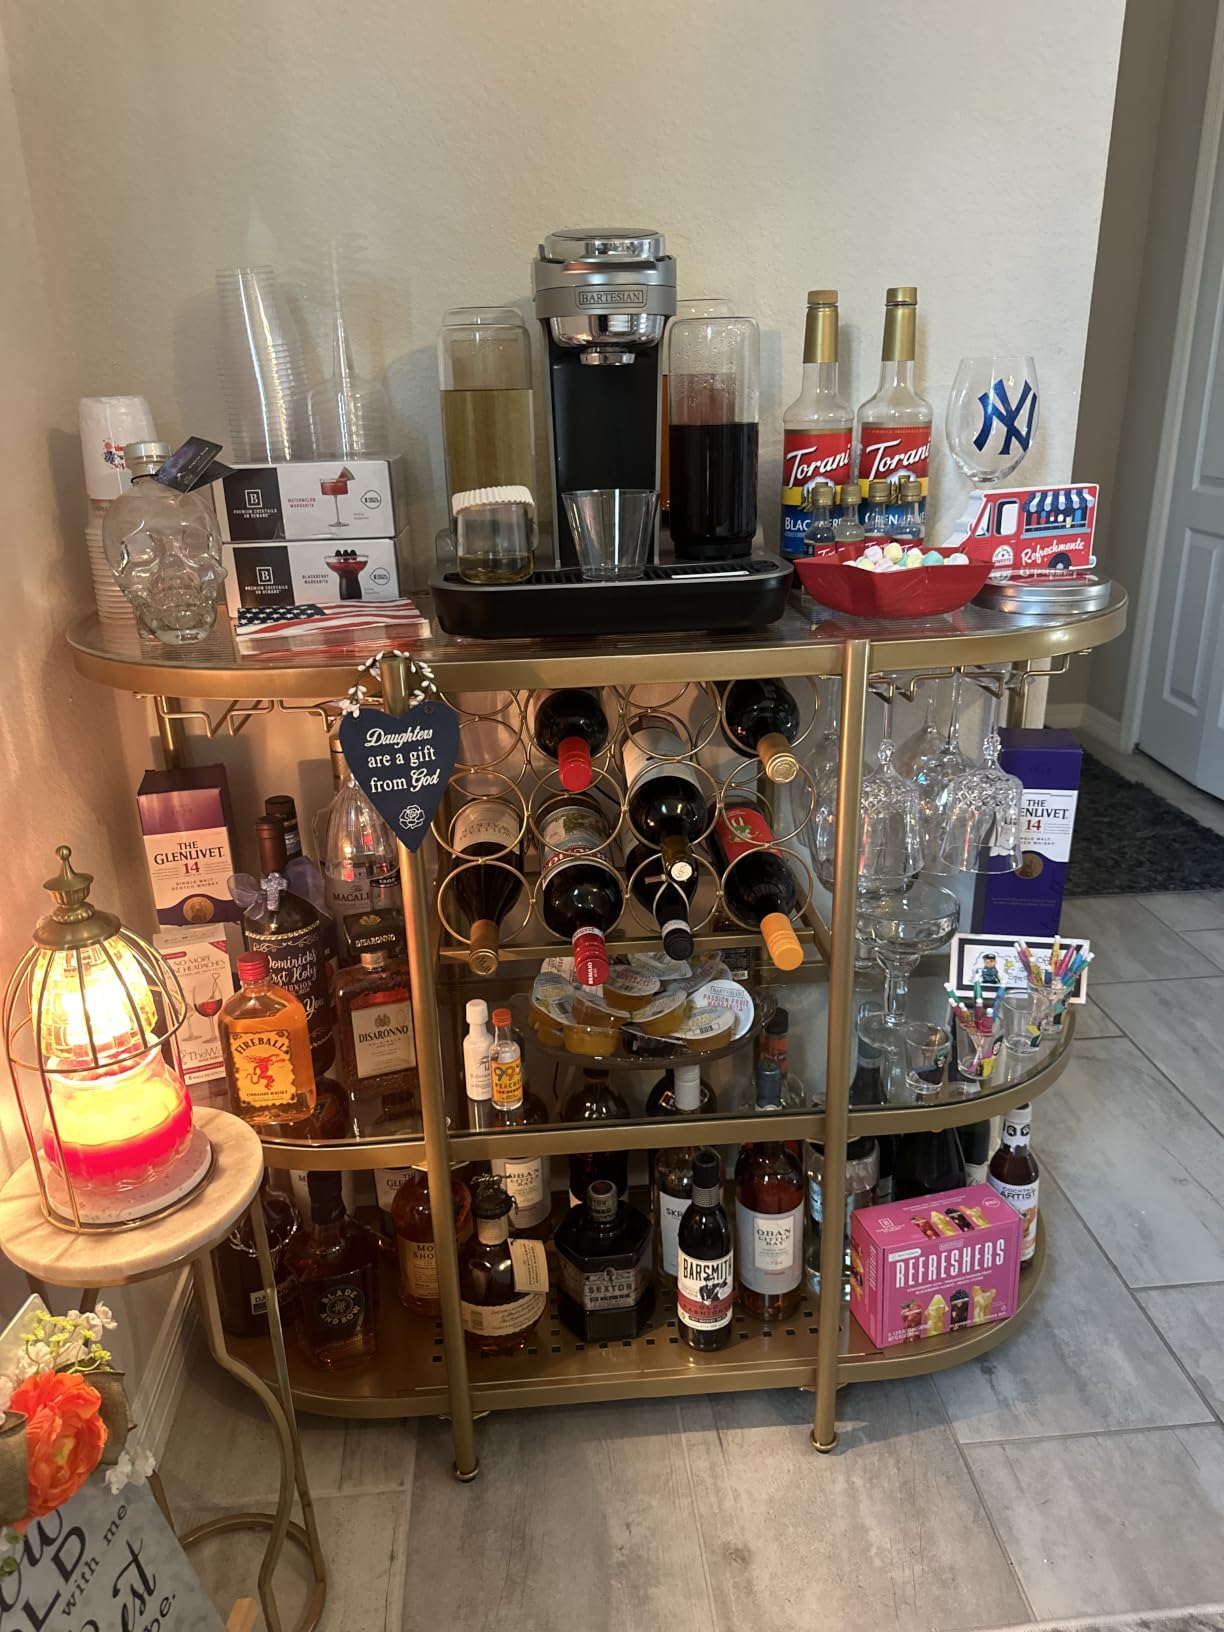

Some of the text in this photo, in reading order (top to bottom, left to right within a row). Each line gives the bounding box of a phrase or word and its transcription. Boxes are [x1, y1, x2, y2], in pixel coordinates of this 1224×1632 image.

[581, 292, 641, 304] BARTESIAN
[973, 378, 1038, 455] NY
[787, 443, 851, 489] Torani
[866, 437, 931, 482] Torani
[249, 493, 259, 504] B
[1021, 538, 1085, 565] Refreshments
[260, 570, 270, 581] B
[364, 725, 433, 748] Daughters
[367, 745, 436, 768] are a gift
[370, 768, 440, 793] from God
[1020, 808, 1070, 820] ENLIVET
[1025, 819, 1042, 831] 14
[177, 841, 198, 850] THE
[154, 847, 225, 865] GLENLIVET
[183, 863, 201, 875] 14
[355, 933, 396, 948] DISARONNO
[291, 965, 317, 982] Holy
[359, 1025, 409, 1043] DISARONNO
[235, 1037, 286, 1055] FIREBALL
[1000, 1190, 1036, 1201] ARTIST
[757, 1227, 791, 1236] OBAN
[758, 1234, 791, 1242] LITTLE
[683, 1255, 732, 1281] BARSMITH
[895, 1239, 1005, 1289] REFRESHERS
[62, 1504, 128, 1617] with me
